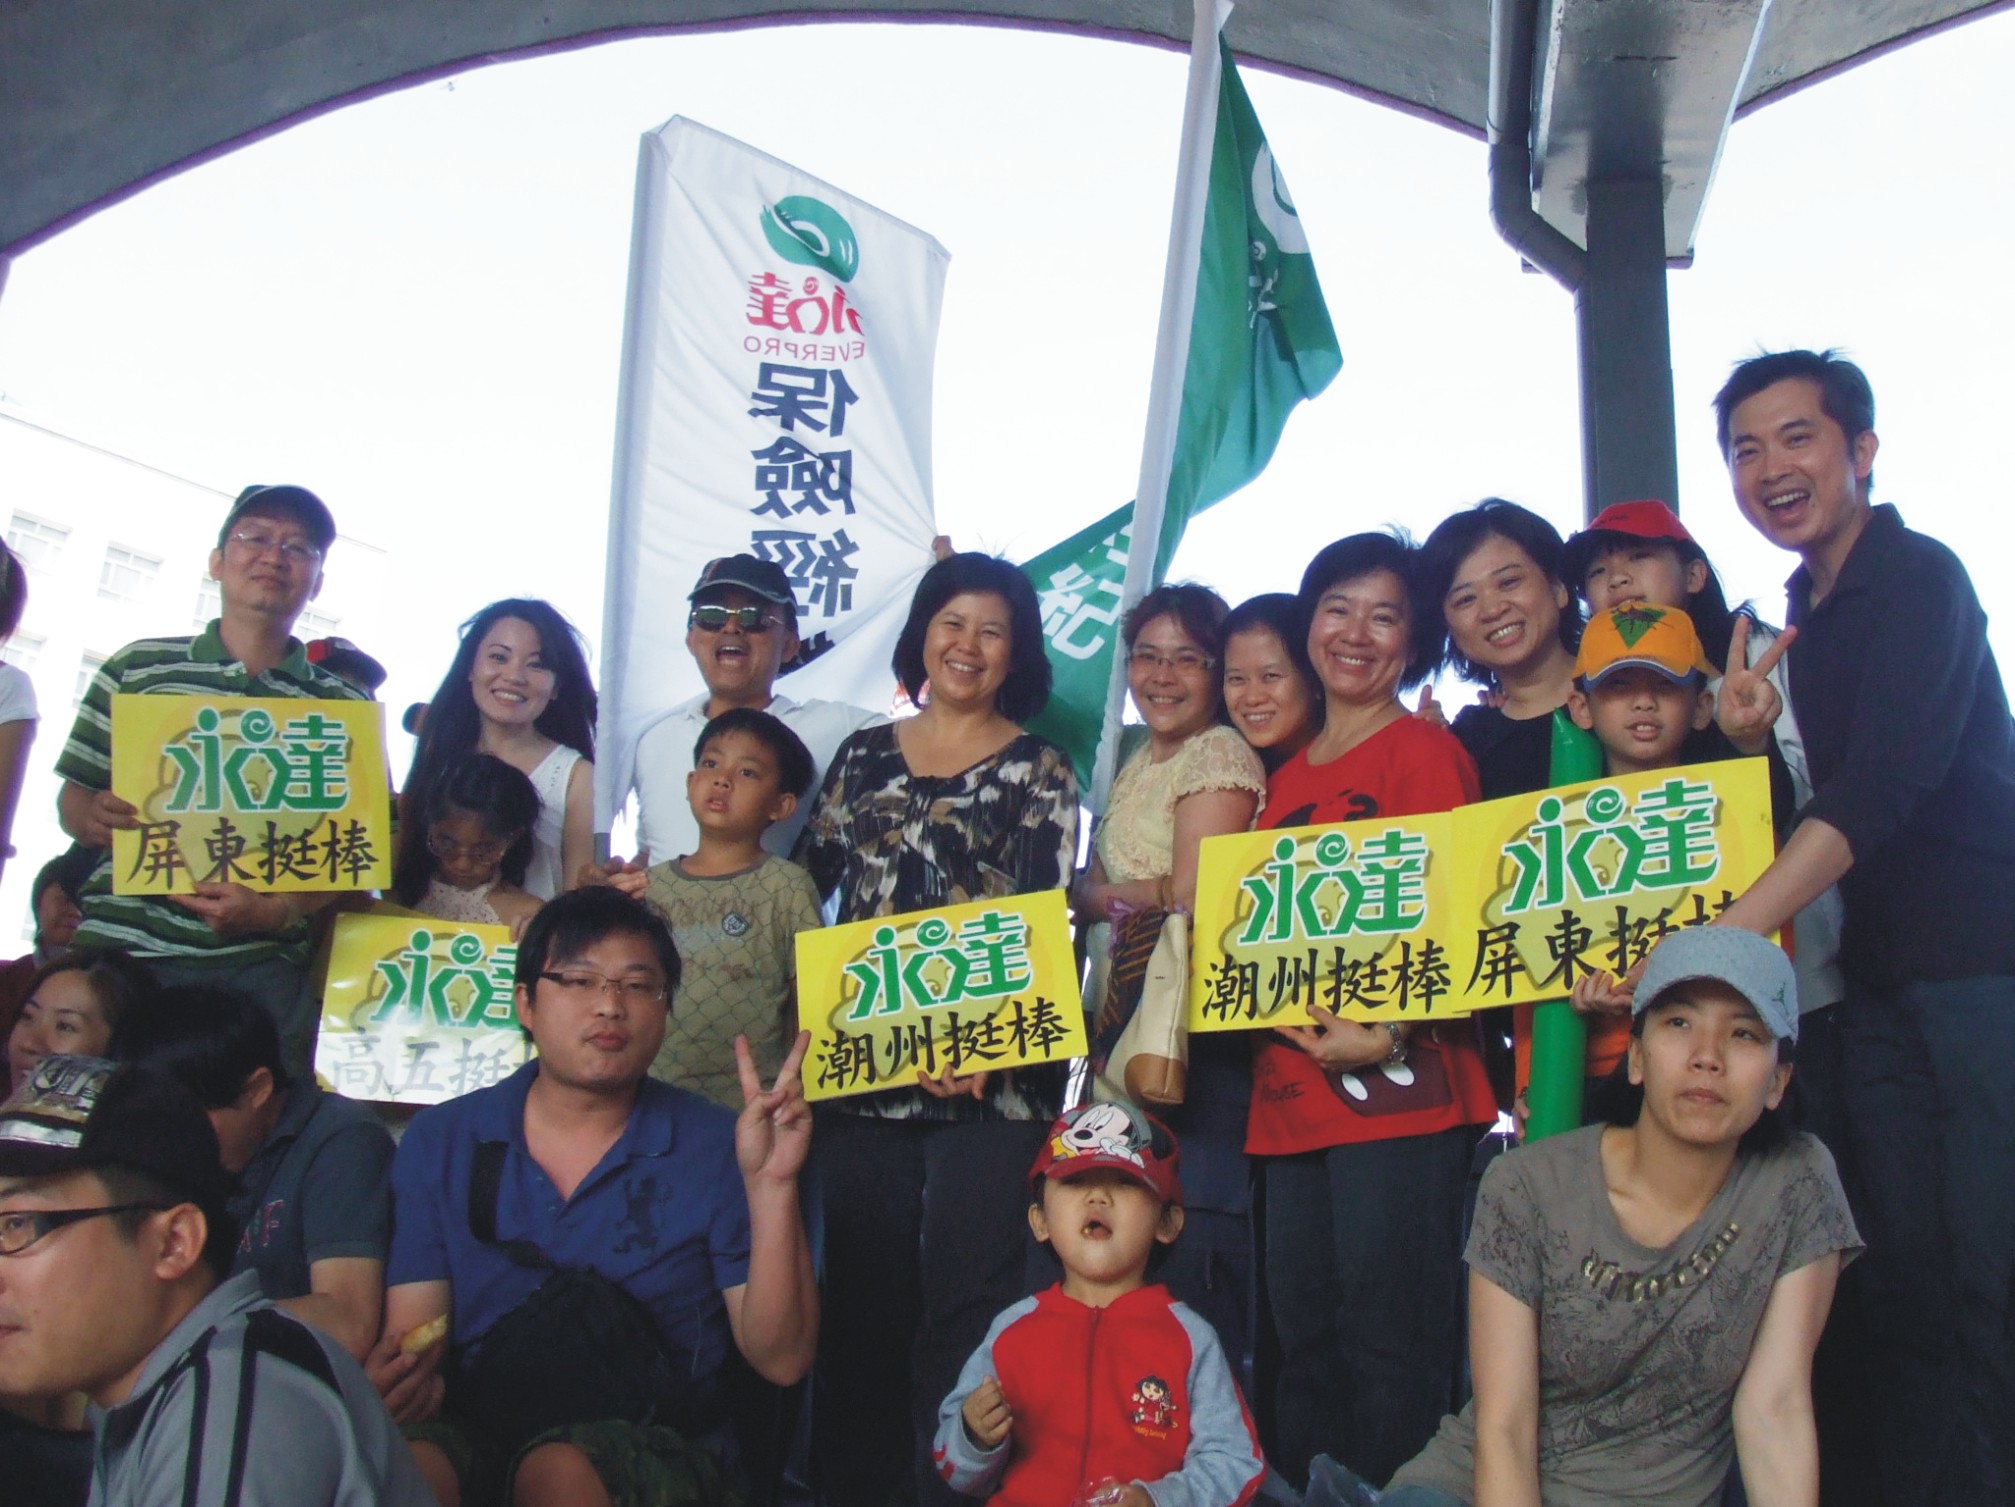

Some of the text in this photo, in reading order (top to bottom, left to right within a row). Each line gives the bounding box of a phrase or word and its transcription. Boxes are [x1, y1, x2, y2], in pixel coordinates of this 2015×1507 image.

[163, 706, 350, 813] 永達
[126, 817, 380, 890] 屏東挺棒
[1241, 829, 1430, 946] 永達
[1502, 777, 1722, 914] 永達
[845, 911, 1032, 1021] 永達
[1200, 938, 1452, 1023] 潮州挺棒
[1464, 889, 1737, 998] 屏東挺
[332, 1026, 533, 1096] 高五挺
[816, 996, 1073, 1090] 潮州挺棒
